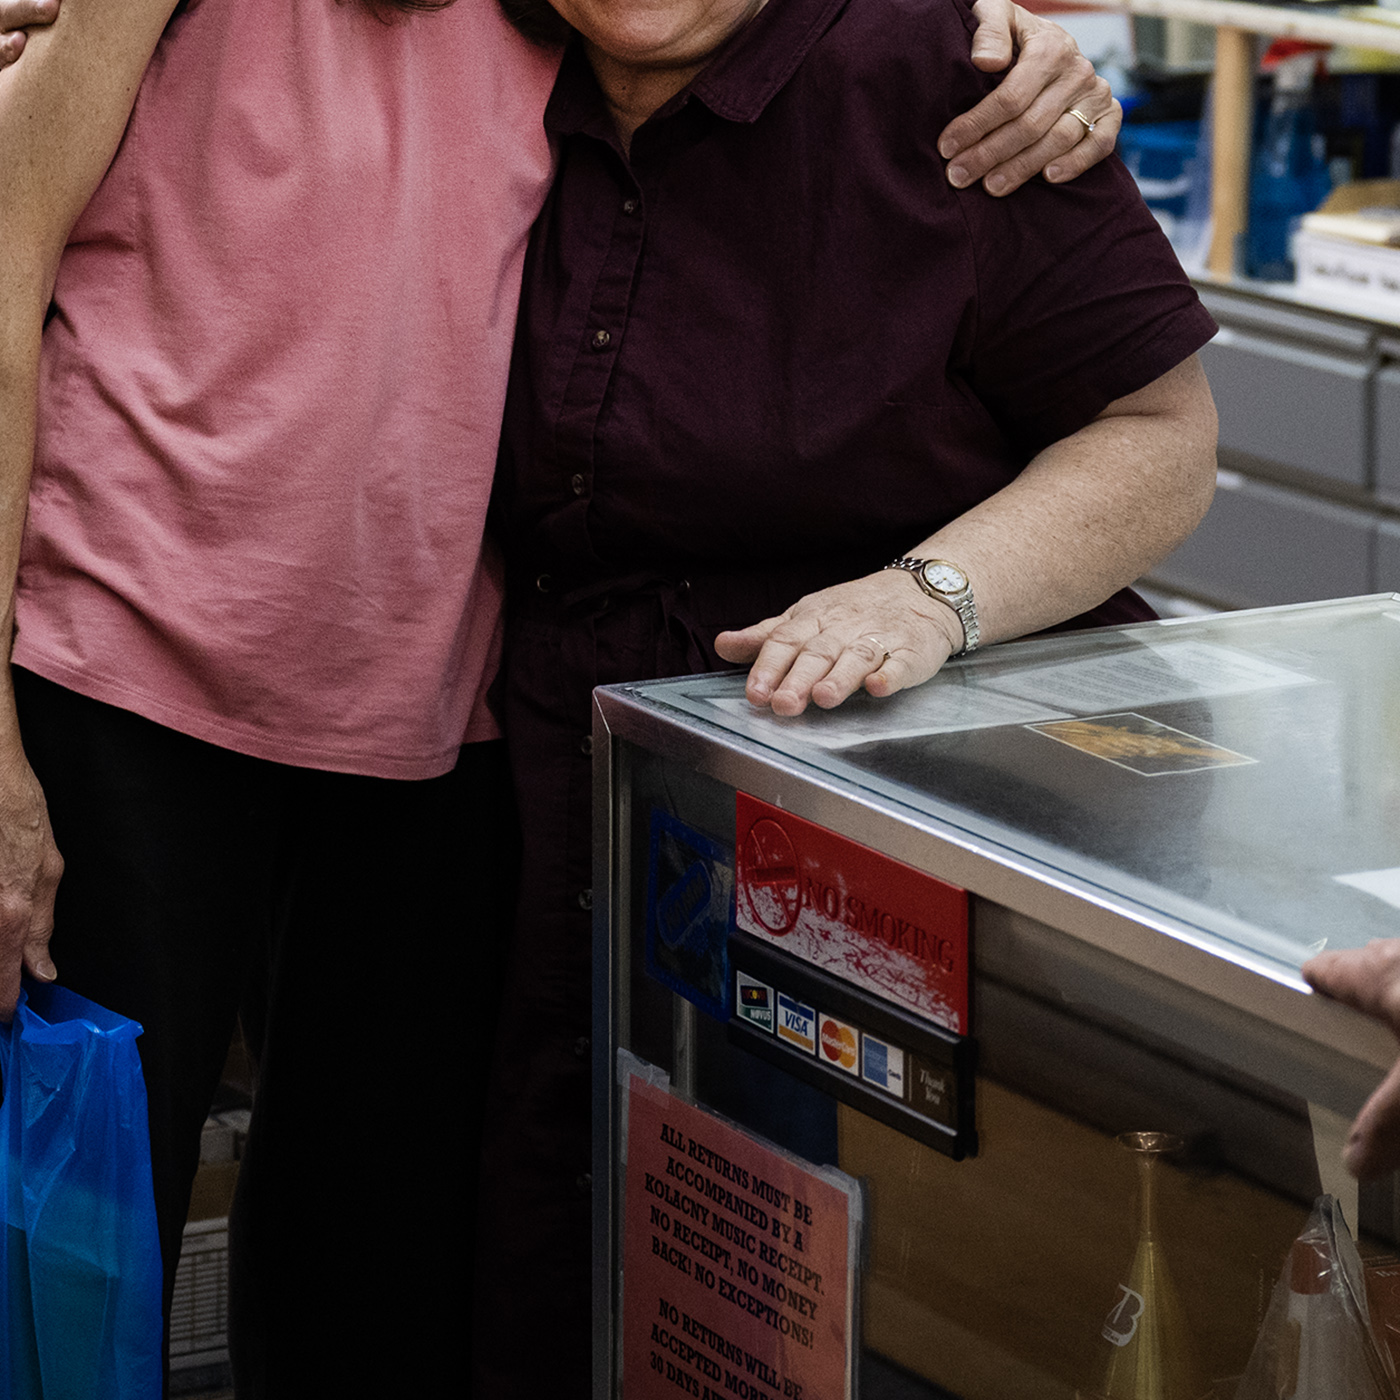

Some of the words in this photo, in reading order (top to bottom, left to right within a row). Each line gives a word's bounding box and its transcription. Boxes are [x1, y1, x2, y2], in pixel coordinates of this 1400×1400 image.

[803, 877, 839, 922] NO
[846, 896, 954, 974] SMOKING
[784, 1010, 809, 1036] VISA
[919, 1068, 946, 1094] Thank
[925, 1085, 941, 1106] You
[660, 1123, 686, 1152] ALL
[688, 1138, 749, 1190] RETURNS
[752, 1175, 791, 1213] MUST
[794, 1199, 813, 1227] BE
[666, 1156, 768, 1231] ACCOMPANIED
[772, 1218, 791, 1244] BY
[794, 1231, 804, 1253] A
[644, 1172, 710, 1226] KOLACNY
[712, 1213, 756, 1255] MUSIC
[759, 1239, 825, 1296] RECEIPT.
[650, 1205, 671, 1232] NO
[672, 1218, 734, 1277] RECEIPT,
[738, 1258, 759, 1287] NO
[762, 1273, 818, 1321] MONEY
[652, 1236, 692, 1276] BACK!
[695, 1262, 716, 1290] NO
[718, 1277, 814, 1350] EXCEPTIONS!
[651, 1323, 722, 1383] ACCEPTED
[651, 1351, 664, 1375] 30
[666, 1360, 699, 1398] DAYS
[659, 1298, 679, 1326] NO
[682, 1313, 743, 1367] RETURNS
[745, 1352, 781, 1391] WILL
[784, 1376, 803, 1400] BE
